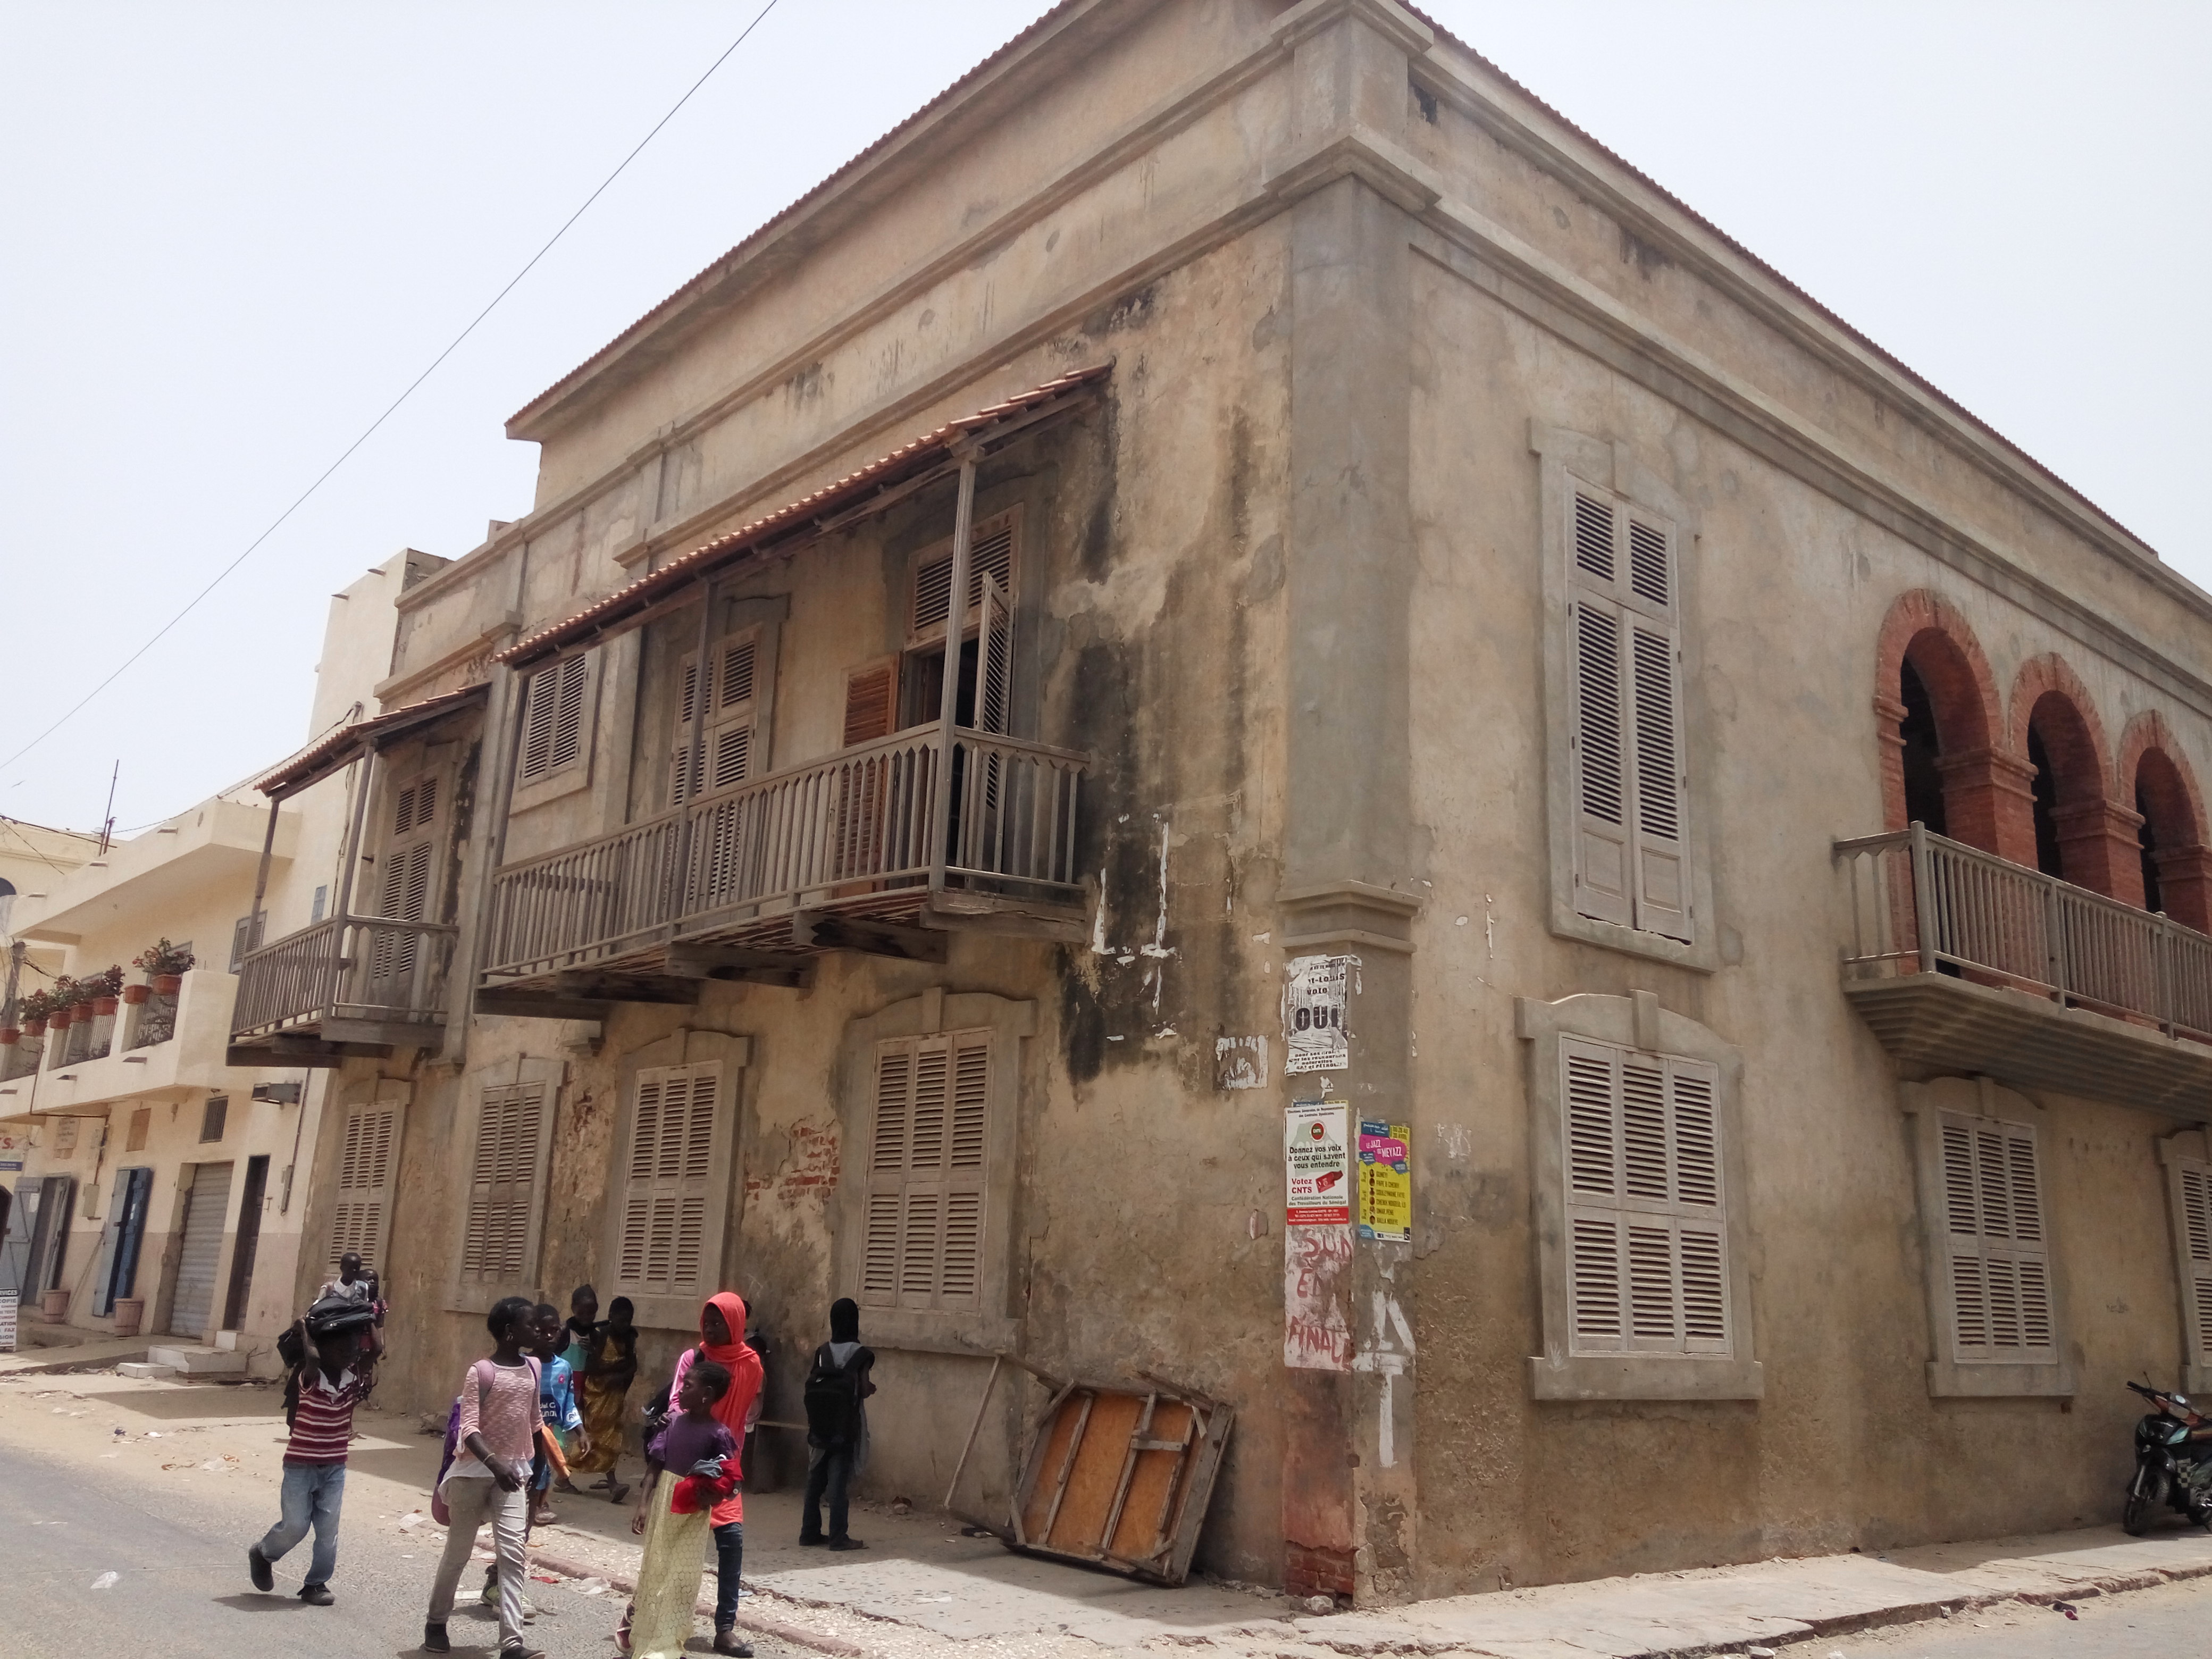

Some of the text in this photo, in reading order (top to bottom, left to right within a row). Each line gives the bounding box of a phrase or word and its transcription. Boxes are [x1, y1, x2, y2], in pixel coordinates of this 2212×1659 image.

[1296, 1006, 1338, 1031] OUI
[1370, 1139, 1381, 1148] JAZZ
[1381, 1146, 1402, 1158] MEYAZZ
[1311, 1153, 1322, 1162] qui
